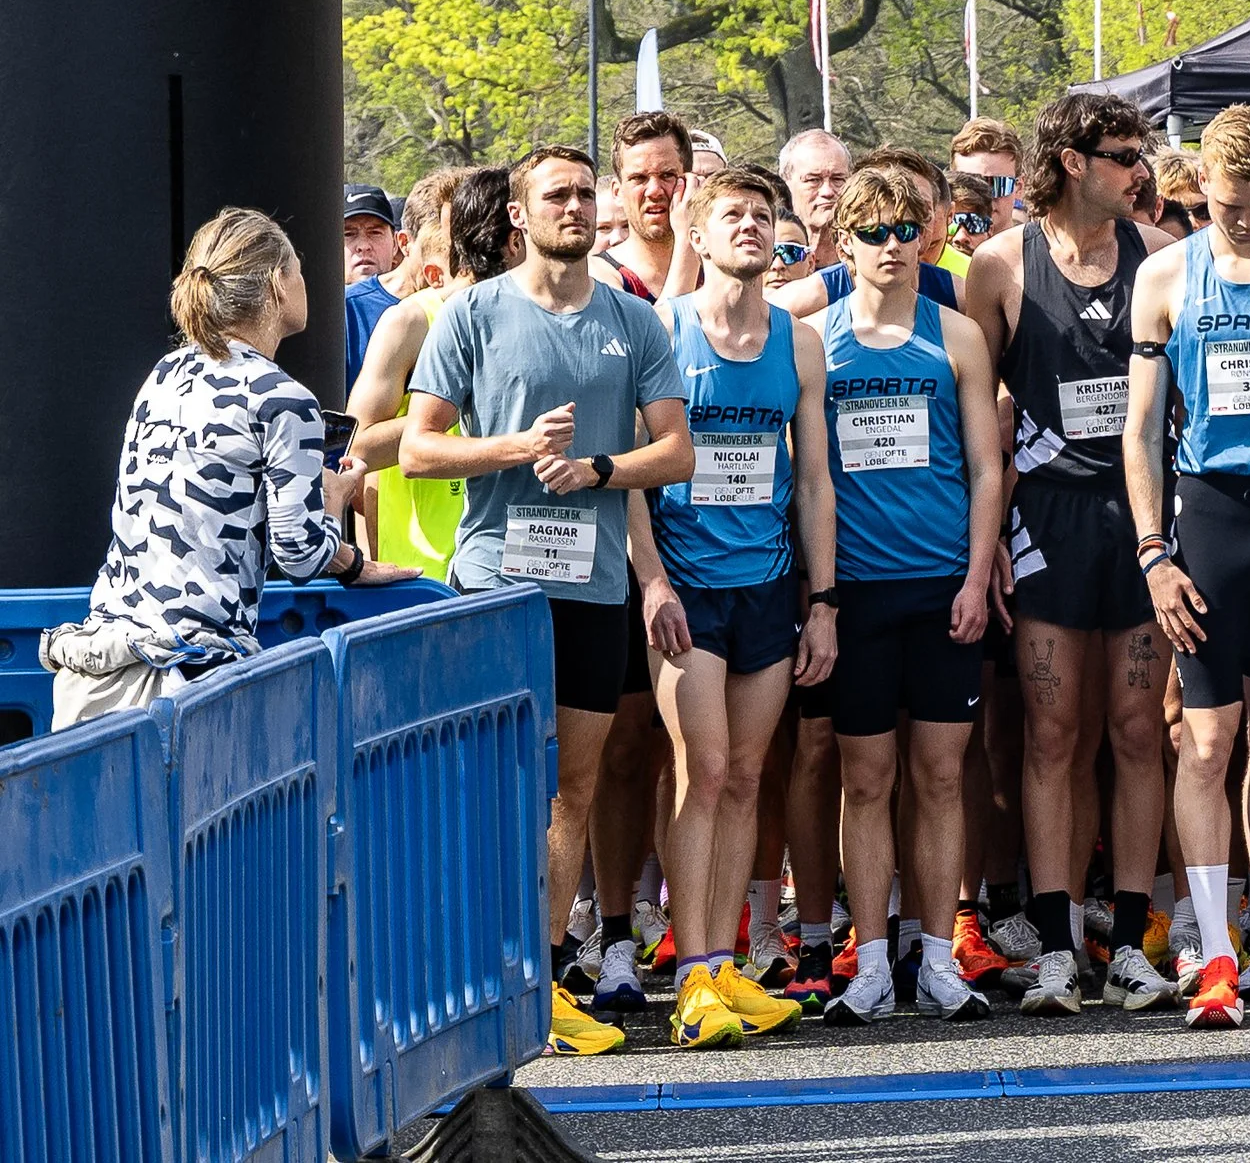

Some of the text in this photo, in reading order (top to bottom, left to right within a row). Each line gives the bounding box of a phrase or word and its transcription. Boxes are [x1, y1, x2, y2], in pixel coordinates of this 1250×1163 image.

[832, 377, 938, 397] SPARTA
[1076, 380, 1129, 395] KRISTIAN
[845, 397, 910, 411] STRANDVEJEN 5K
[1095, 404, 1116, 415] 427
[689, 405, 784, 426] SPARTA
[852, 414, 915, 427] CHRISTIAN
[865, 425, 902, 435] ENGEDAL
[701, 434, 763, 445] STRANDVEJEN 5K
[873, 437, 896, 447] 420
[713, 451, 760, 462] NICOLAI
[717, 462, 755, 470] HARTLING
[726, 474, 747, 484] 140
[516, 507, 581, 520] STRANDVEJEN 5K
[528, 524, 578, 538] RAGNAR
[528, 534, 576, 546] RASMUSSEN
[544, 548, 558, 559] 11
